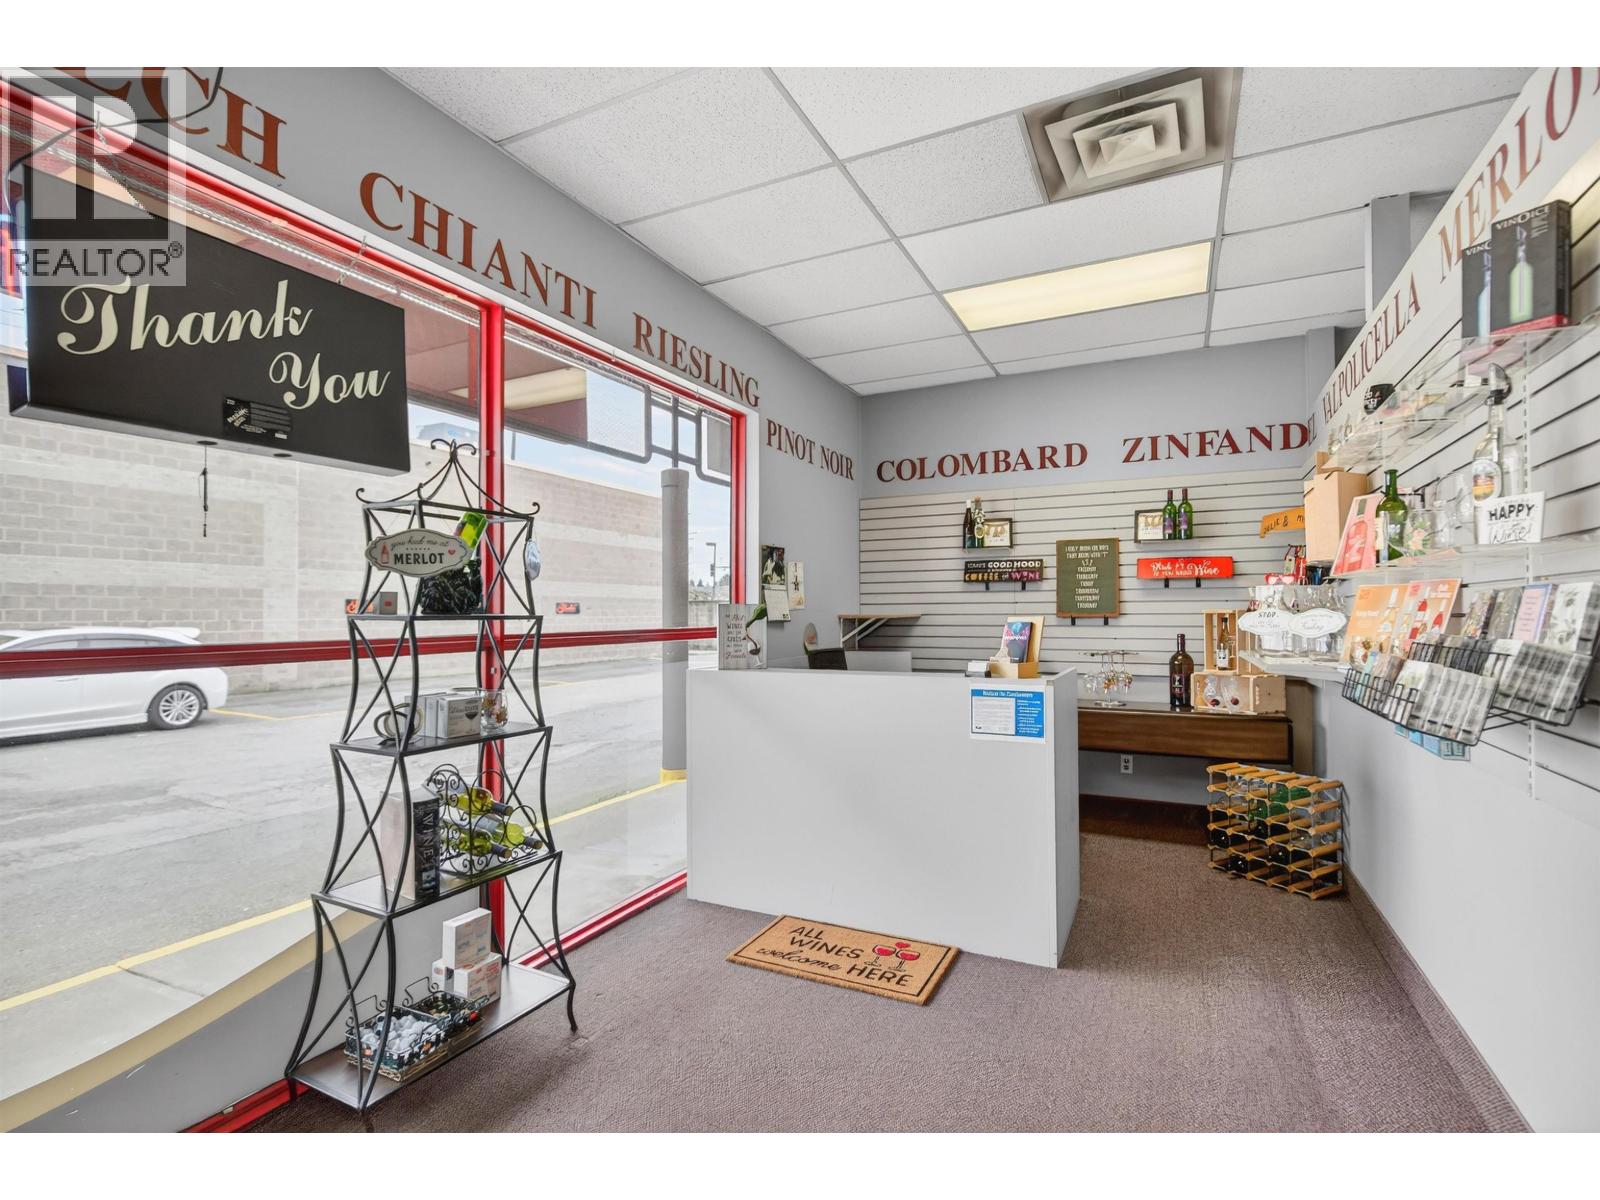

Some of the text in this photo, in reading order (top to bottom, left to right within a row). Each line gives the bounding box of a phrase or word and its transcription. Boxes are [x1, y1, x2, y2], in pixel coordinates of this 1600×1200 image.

[54, 67, 287, 179] CH
[1438, 67, 1600, 284] MERLO
[360, 171, 597, 329] CHIANTI
[57, 275, 313, 355] Thank
[633, 311, 760, 409] RIESLING
[1322, 271, 1421, 425] VALPOLICELLA
[269, 351, 391, 410] You
[767, 418, 855, 481] PINOT NOIR
[877, 442, 1088, 484] COLOMBARD
[1488, 503, 1535, 521] HAPPY
[394, 552, 445, 565] MERLOT
[789, 935, 865, 959] WINES
[791, 925, 824, 940] ALL
[757, 947, 914, 987] welcome HERE
